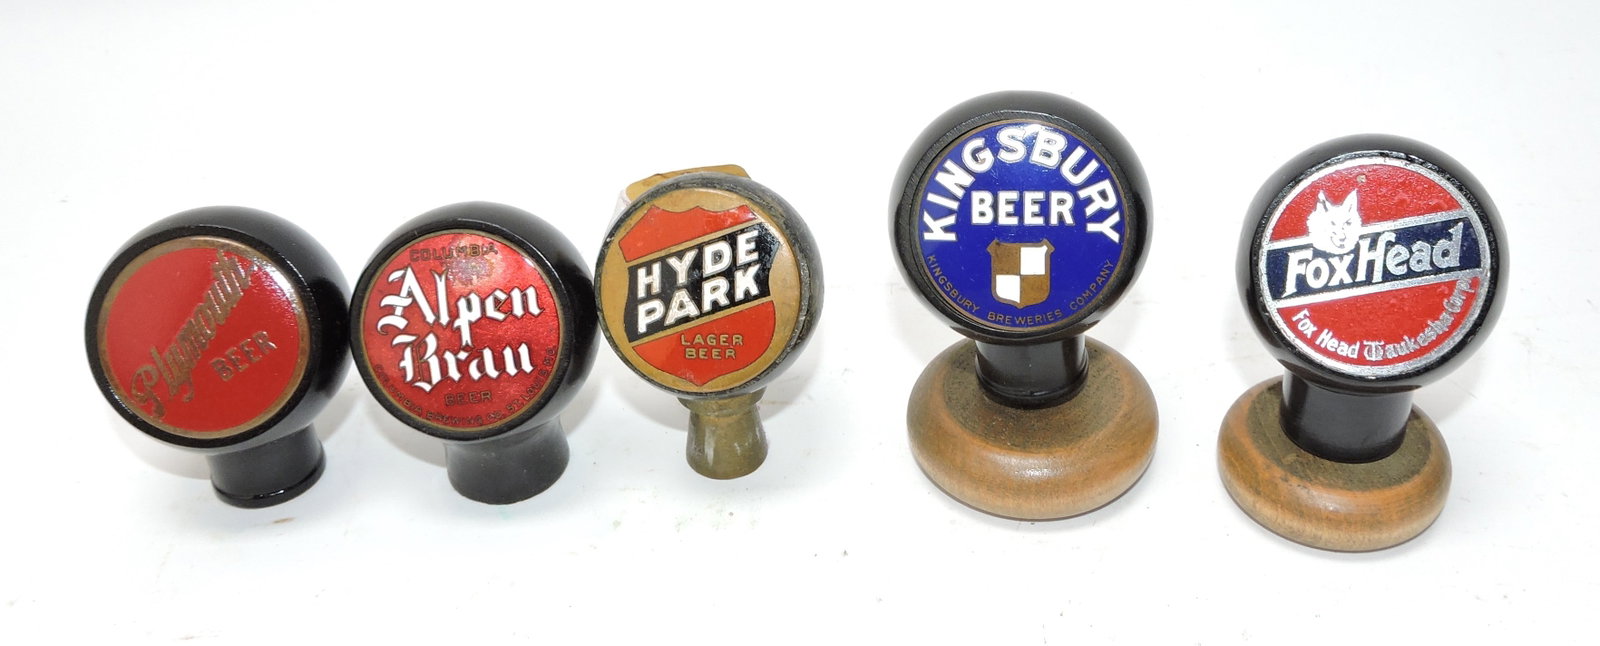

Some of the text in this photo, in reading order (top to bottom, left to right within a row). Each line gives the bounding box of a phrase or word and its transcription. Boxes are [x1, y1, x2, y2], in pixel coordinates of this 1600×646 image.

[922, 122, 1121, 245] KINGSBURY
[970, 190, 1076, 226] BEER
[409, 242, 499, 262] COLUMBIA
[636, 229, 760, 301] HYDE
[376, 264, 545, 348] Alpen
[637, 263, 761, 336] PARK
[926, 254, 1115, 325] KINGSBURY BREWERIES COMPANY
[130, 248, 252, 420] Plymouth
[209, 331, 278, 382] BEER
[680, 333, 744, 348] LAGER
[685, 348, 737, 361] BEER
[1291, 307, 1318, 339] Fox
[1315, 331, 1359, 360] Head
[1363, 312, 1455, 362] Waukesha
[444, 390, 493, 407] BEER
